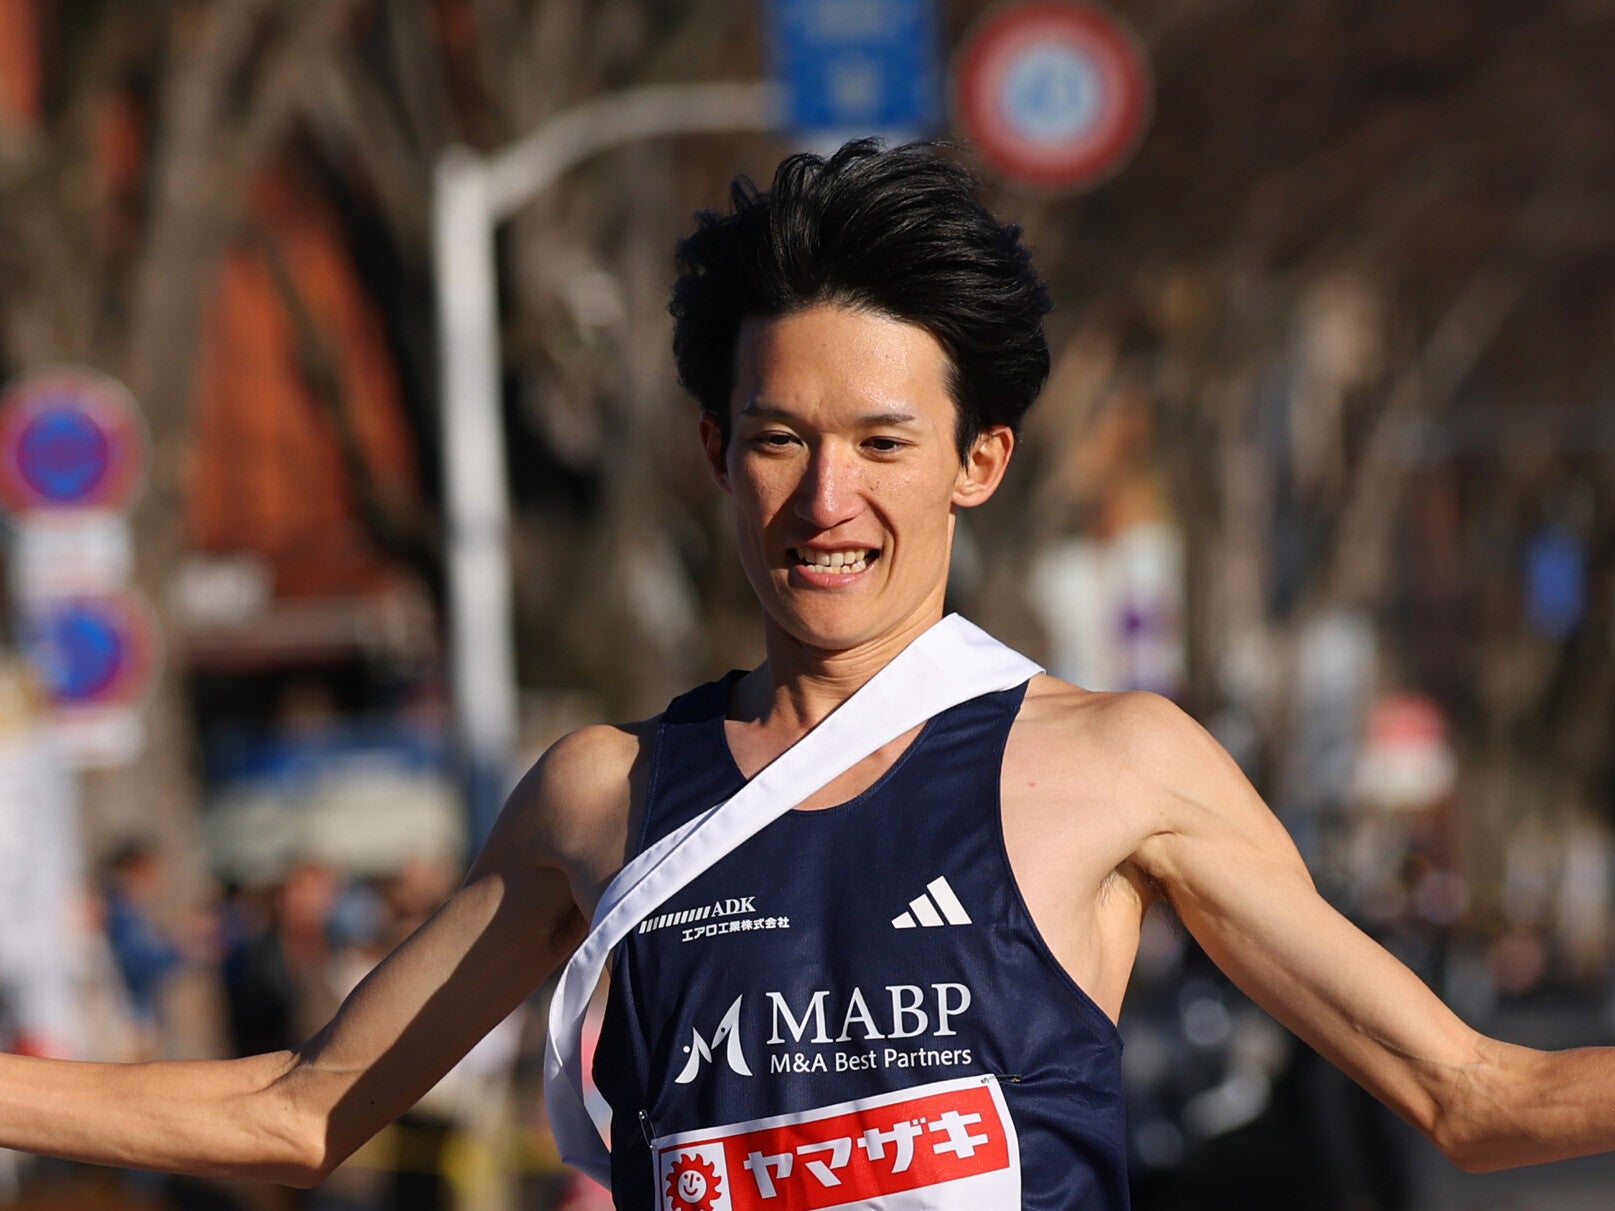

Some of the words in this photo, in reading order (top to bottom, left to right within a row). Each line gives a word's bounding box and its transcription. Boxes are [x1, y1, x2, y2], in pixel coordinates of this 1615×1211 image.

[711, 896, 756, 917] ADK
[682, 916, 790, 942] エアロ工業株式会社
[765, 983, 972, 1045] MABP
[770, 1051, 828, 1074] M&A
[835, 1050, 877, 1072] Best
[884, 1047, 972, 1069] Partners
[743, 1110, 988, 1199] ヤマザキ
